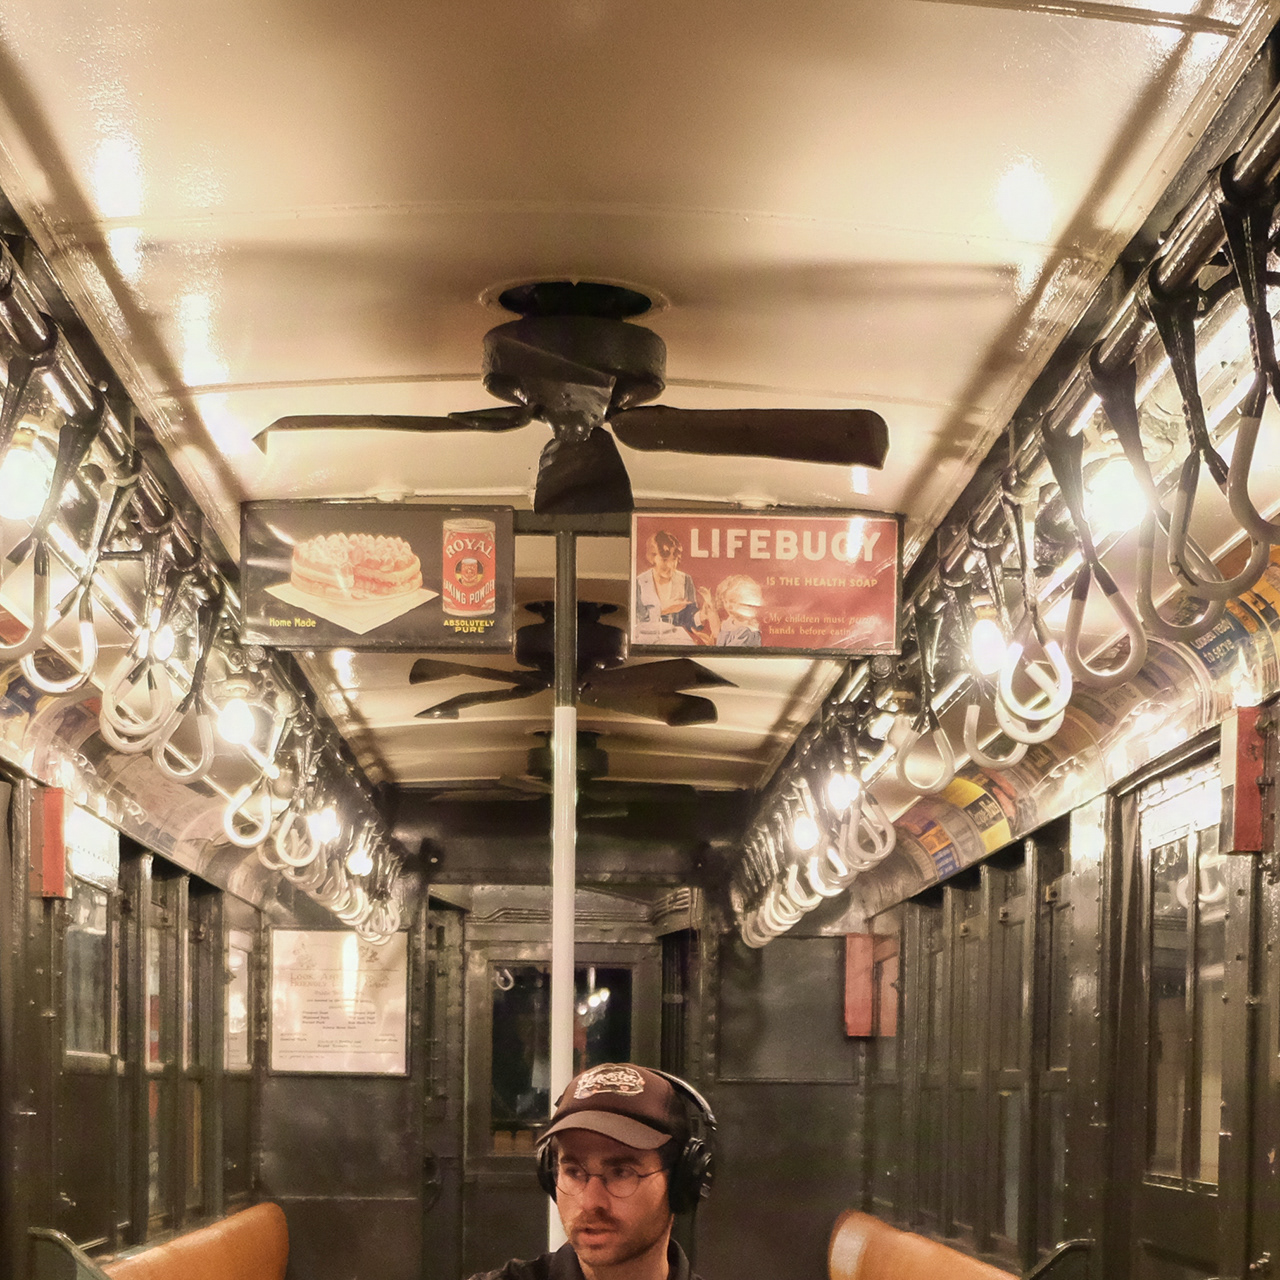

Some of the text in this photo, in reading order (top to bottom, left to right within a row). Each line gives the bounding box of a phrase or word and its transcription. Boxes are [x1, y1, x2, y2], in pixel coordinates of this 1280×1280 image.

[447, 537, 494, 559] ROYAL
[690, 528, 882, 562] LIFEBUOY
[766, 576, 878, 588] IS THE HEALTH SOAP
[269, 618, 317, 628] Home Made
[443, 620, 496, 628] ABSOLUTELY
[785, 614, 820, 624] children
[823, 616, 845, 624] must
[769, 626, 795, 635] hands
[800, 626, 826, 636] before
[1204, 639, 1233, 663] to serve
